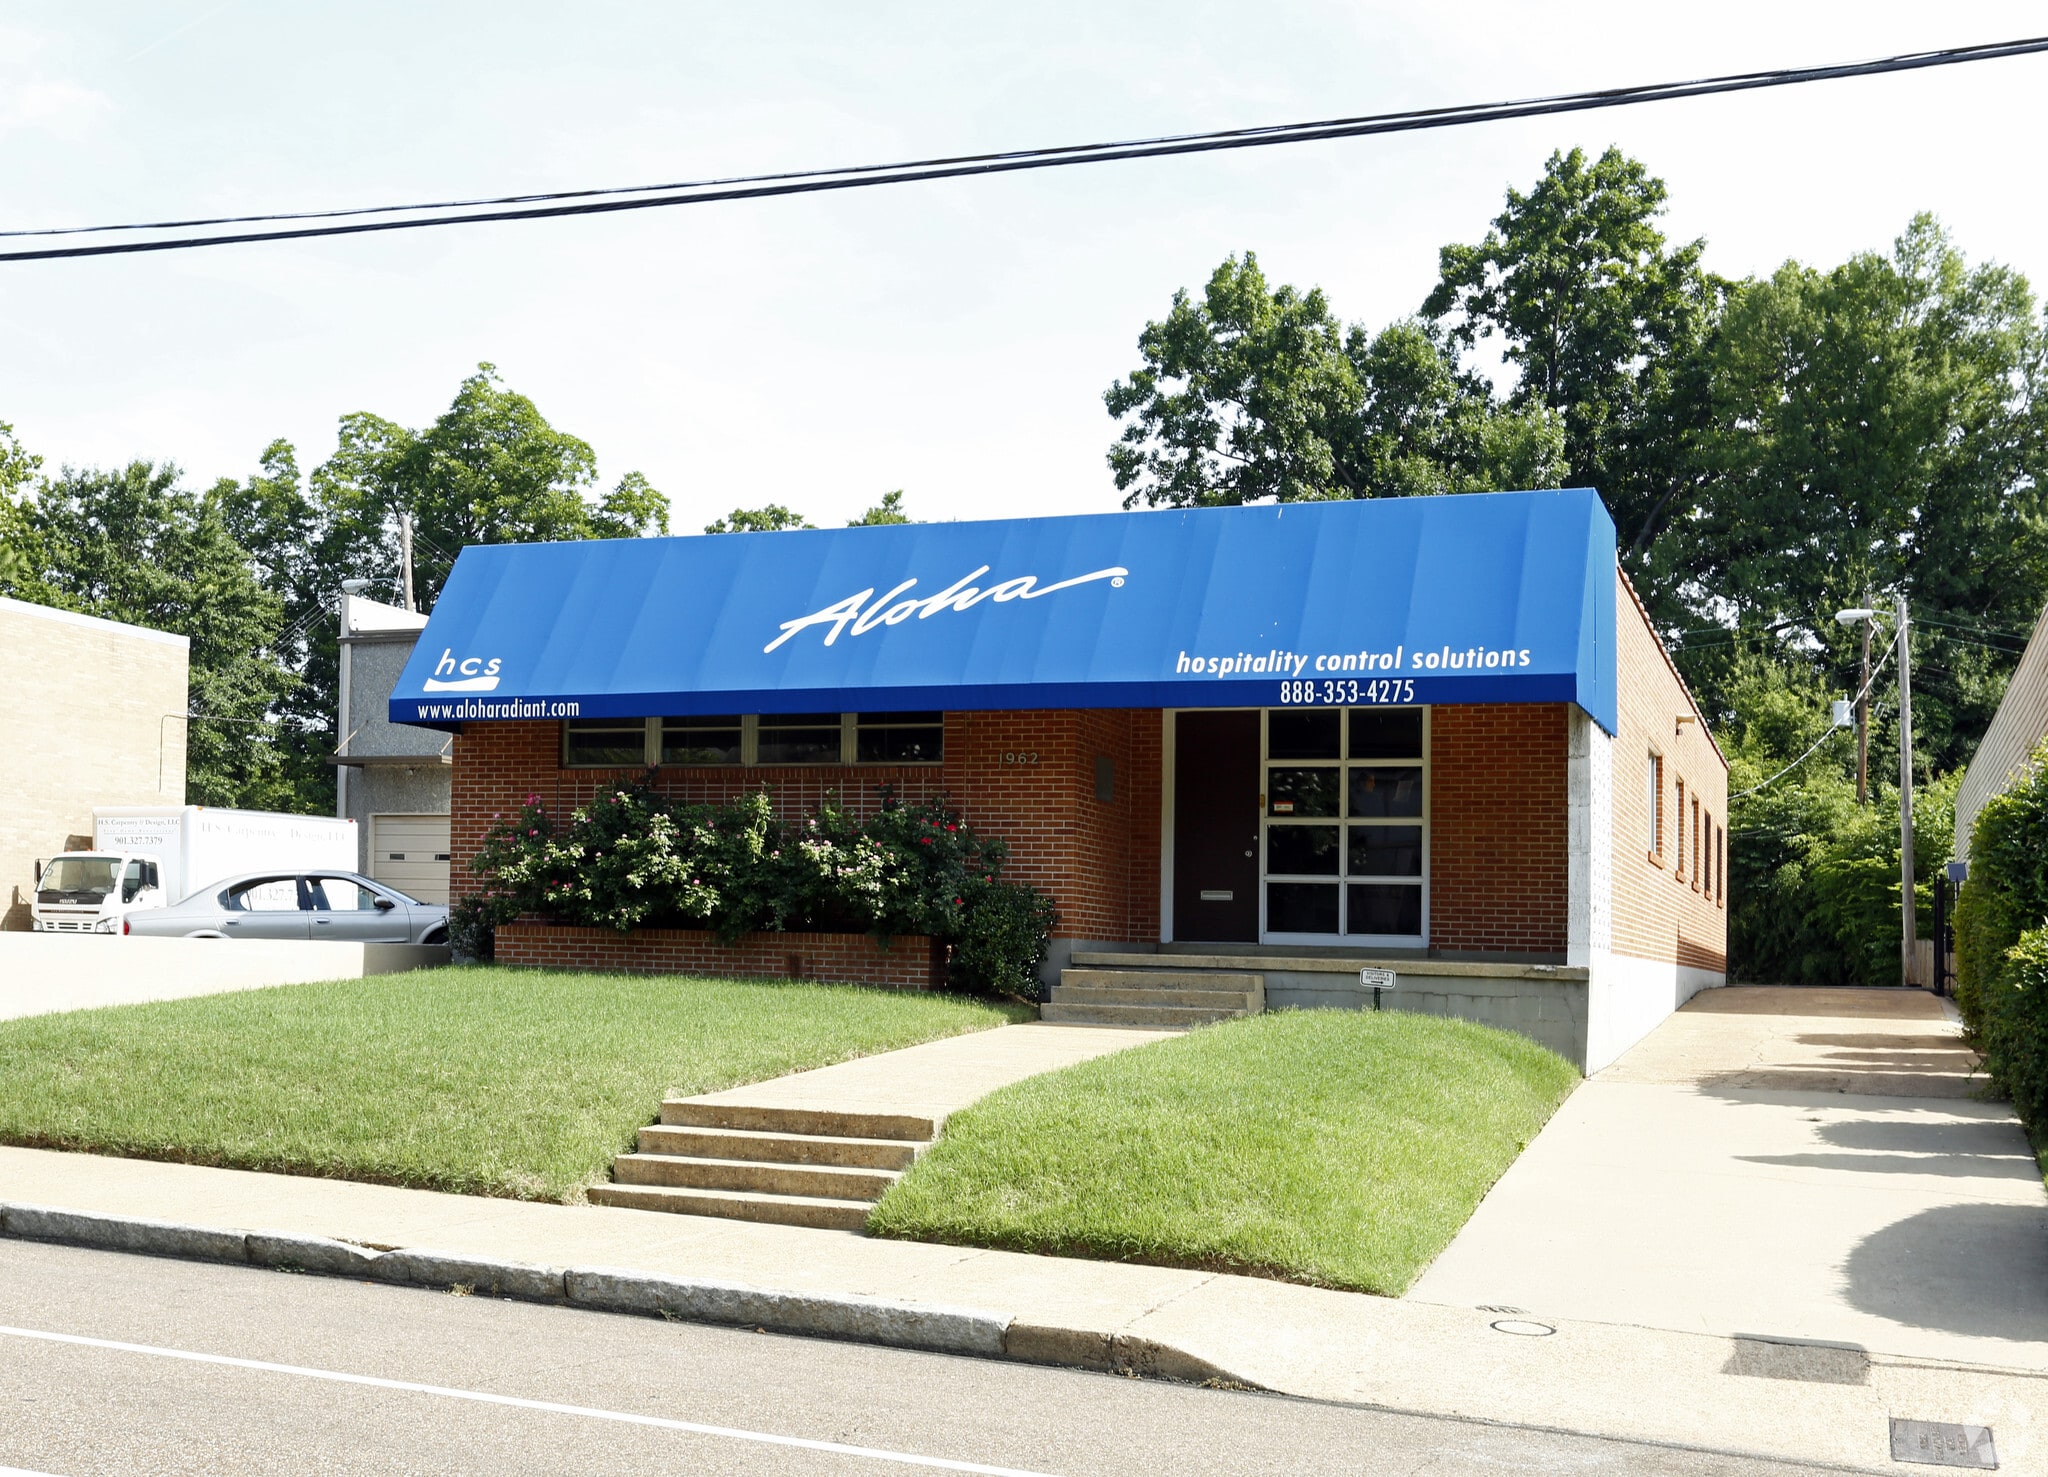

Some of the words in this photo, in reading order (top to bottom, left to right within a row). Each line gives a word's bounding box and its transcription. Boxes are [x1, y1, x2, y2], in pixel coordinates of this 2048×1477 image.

[763, 564, 1129, 655] Aloha
[434, 648, 502, 676] hcs
[1176, 649, 1309, 679] hospitality
[1315, 645, 1403, 671] control
[1411, 646, 1531, 669] solutions
[1280, 679, 1415, 704] 888-353-4275
[417, 698, 580, 720] www.aloharadiant.com
[999, 752, 1039, 766] 1962
[111, 819, 138, 827] Carpentry
[114, 836, 163, 845] 901.327.7379
